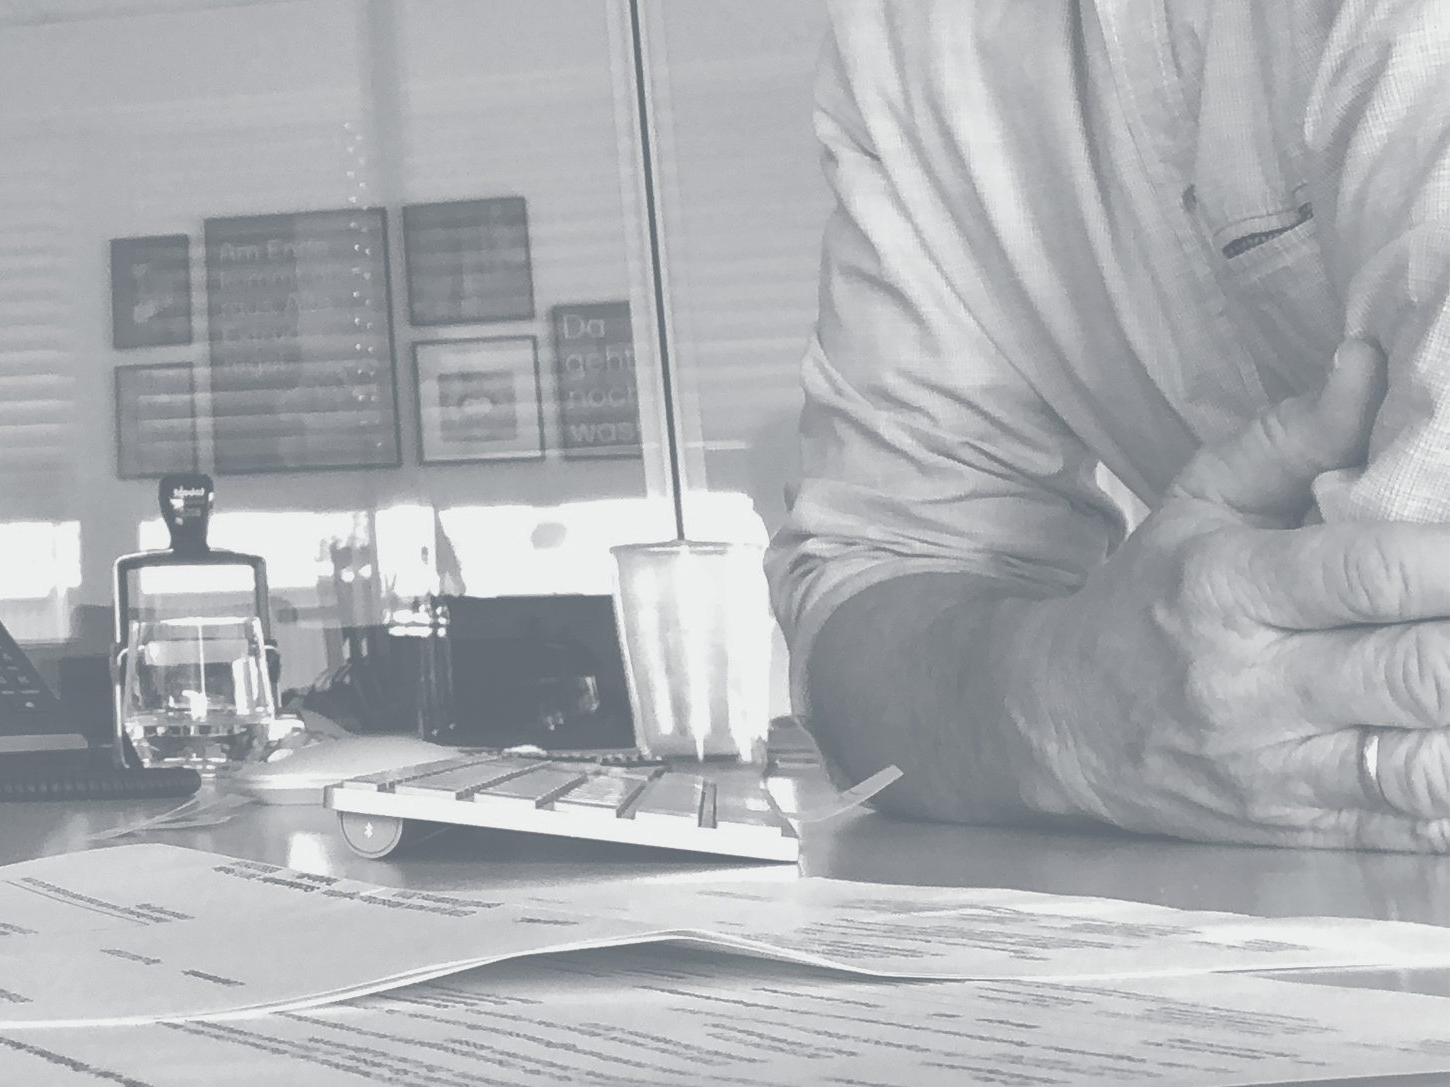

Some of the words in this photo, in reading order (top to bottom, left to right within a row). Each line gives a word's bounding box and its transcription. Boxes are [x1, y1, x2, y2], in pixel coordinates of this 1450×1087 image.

[219, 242, 259, 262] Am
[564, 314, 605, 339] Da
[570, 423, 634, 444] was
